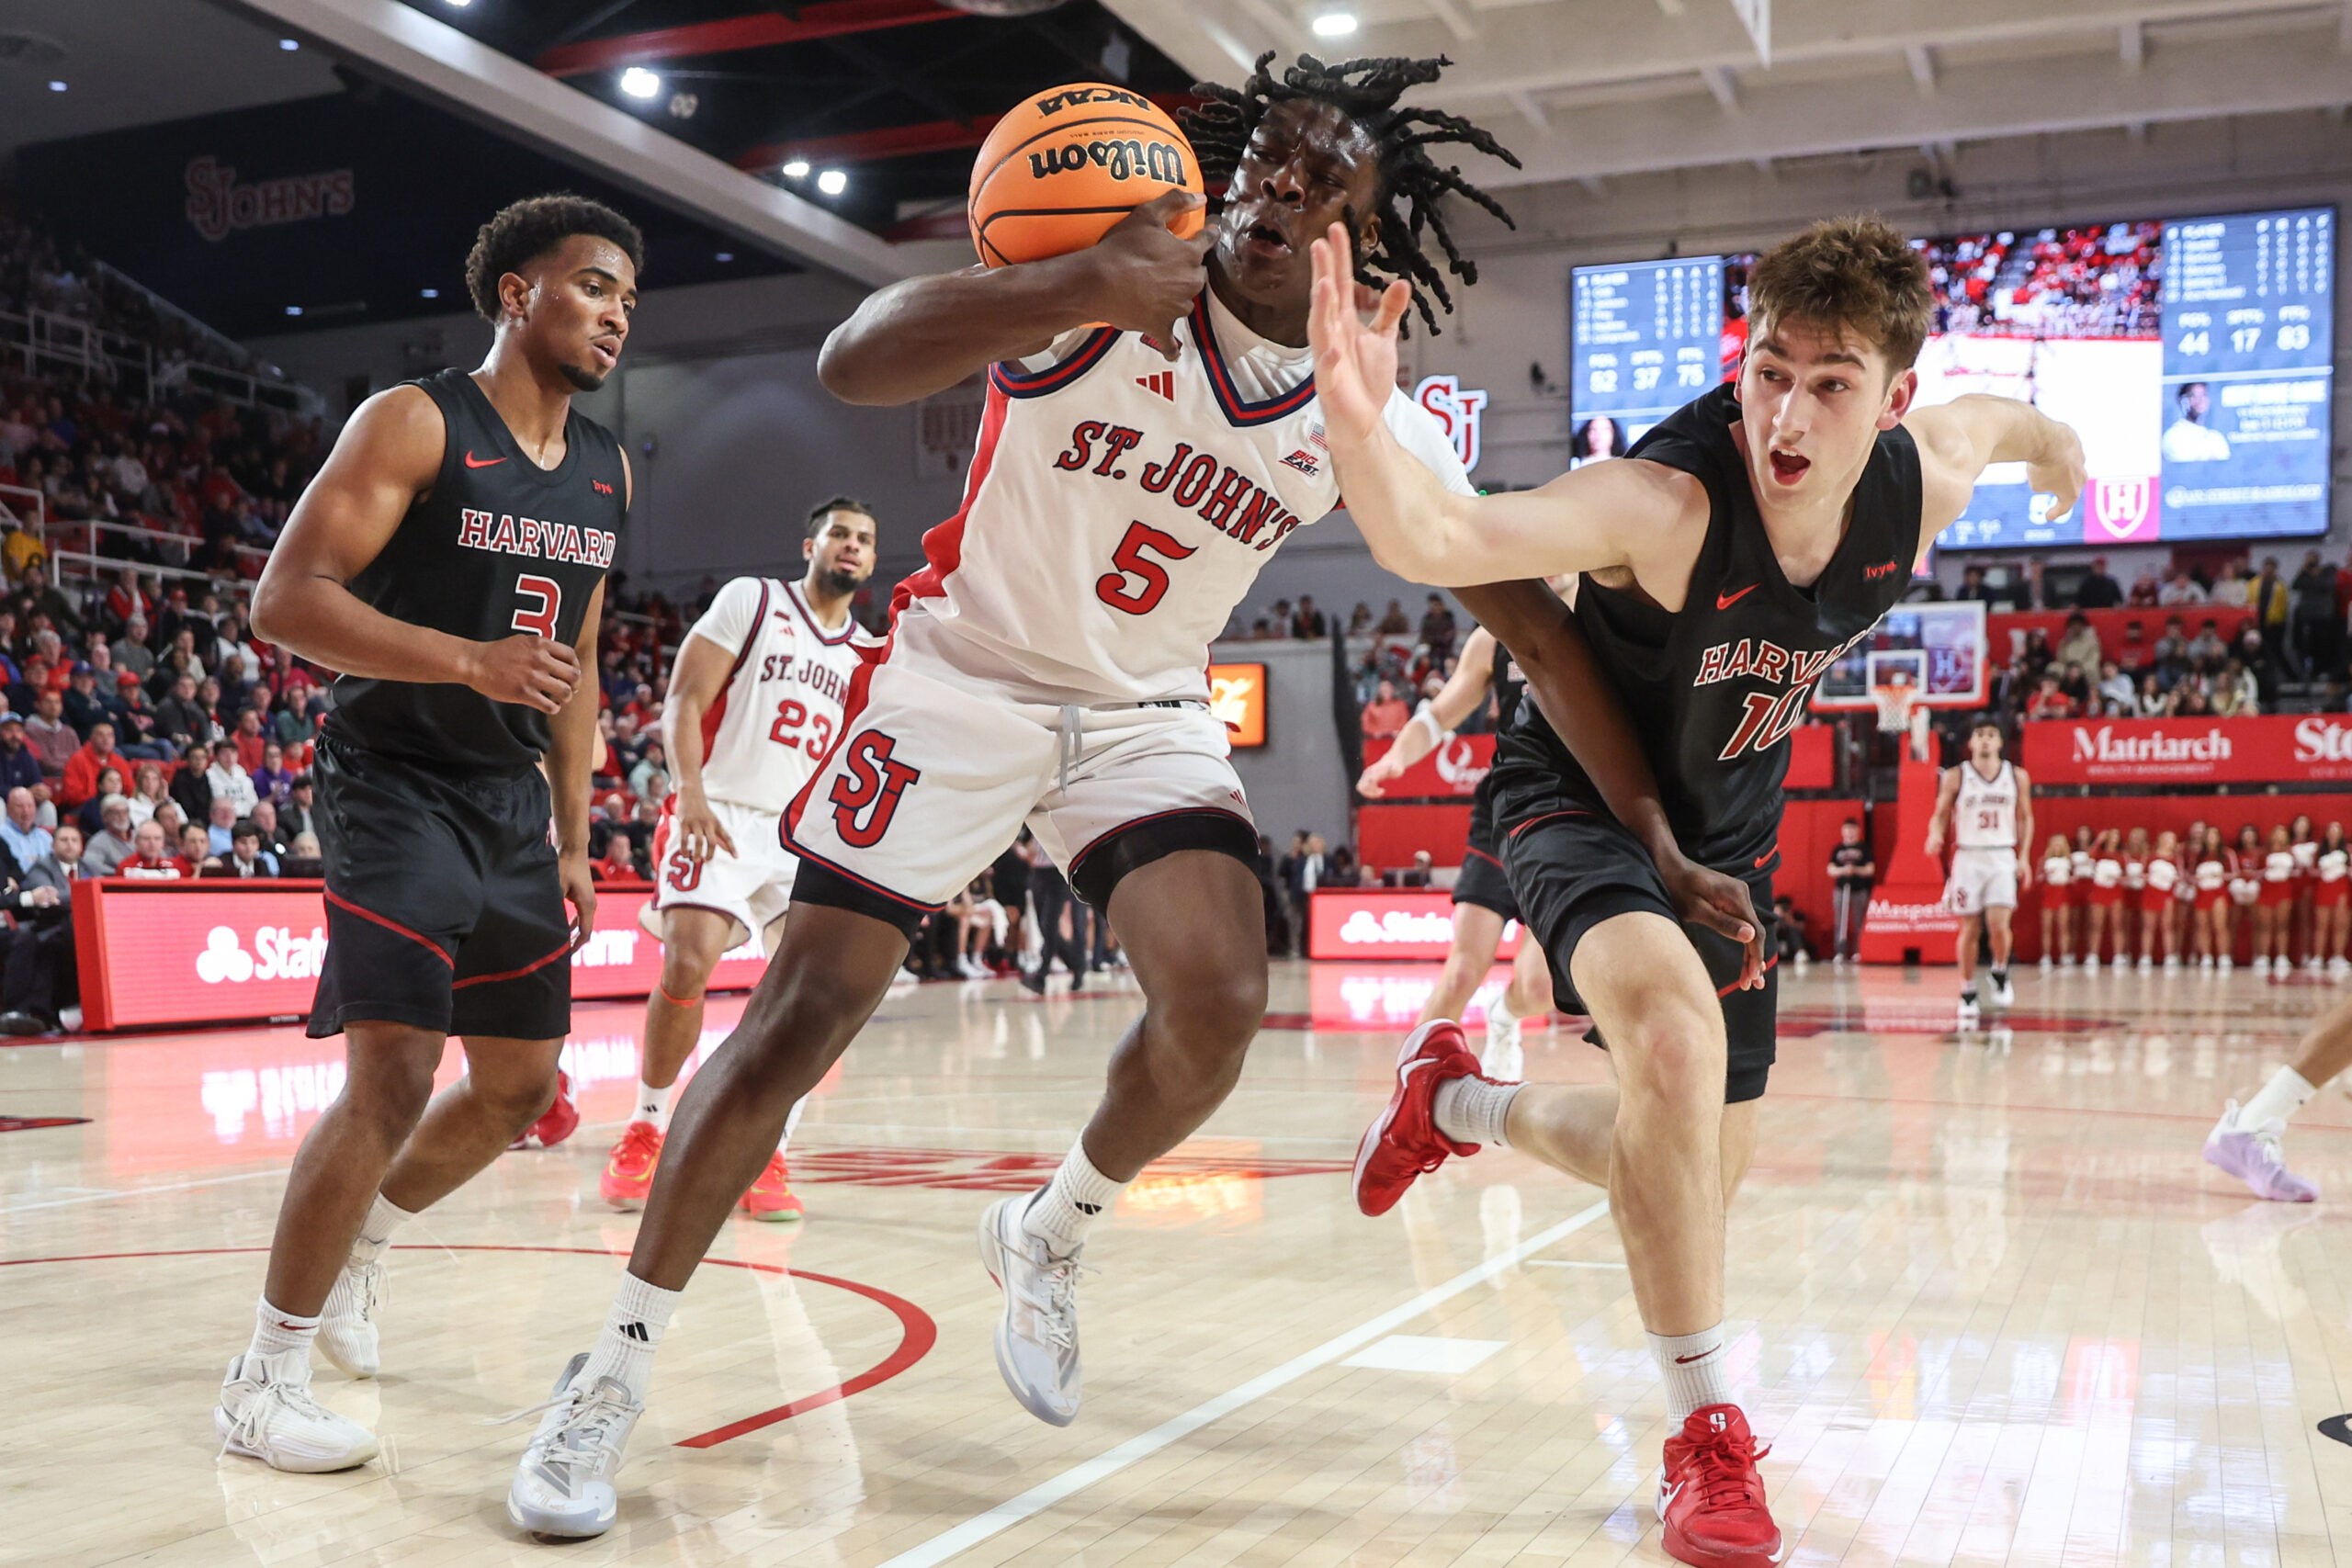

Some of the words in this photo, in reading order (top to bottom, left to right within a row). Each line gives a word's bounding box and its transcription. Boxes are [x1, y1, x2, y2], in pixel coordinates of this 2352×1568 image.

[1035, 88, 1151, 117] NCAA
[1026, 139, 1187, 187] Wilson
[2178, 331, 2210, 355] 44
[2231, 327, 2261, 353] 17
[2277, 324, 2310, 351] 83
[1589, 369, 1618, 393] 52
[1634, 367, 1661, 390] 37
[1677, 364, 1705, 387] 75
[1292, 450, 1318, 465] BIG
[1053, 421, 1144, 479] ST.
[1140, 443, 1301, 551] JOHN'S
[458, 507, 616, 569] HARVARD
[1095, 520, 1199, 615] 5
[511, 573, 561, 641] 3
[760, 655, 793, 682] ST.
[769, 699, 832, 761] 23
[1717, 680, 1811, 761] 10
[2072, 725, 2232, 763] Matriarch
[1978, 810, 1999, 829] 31
[1867, 898, 1955, 922] Maspet
[254, 926, 329, 980] Stat
